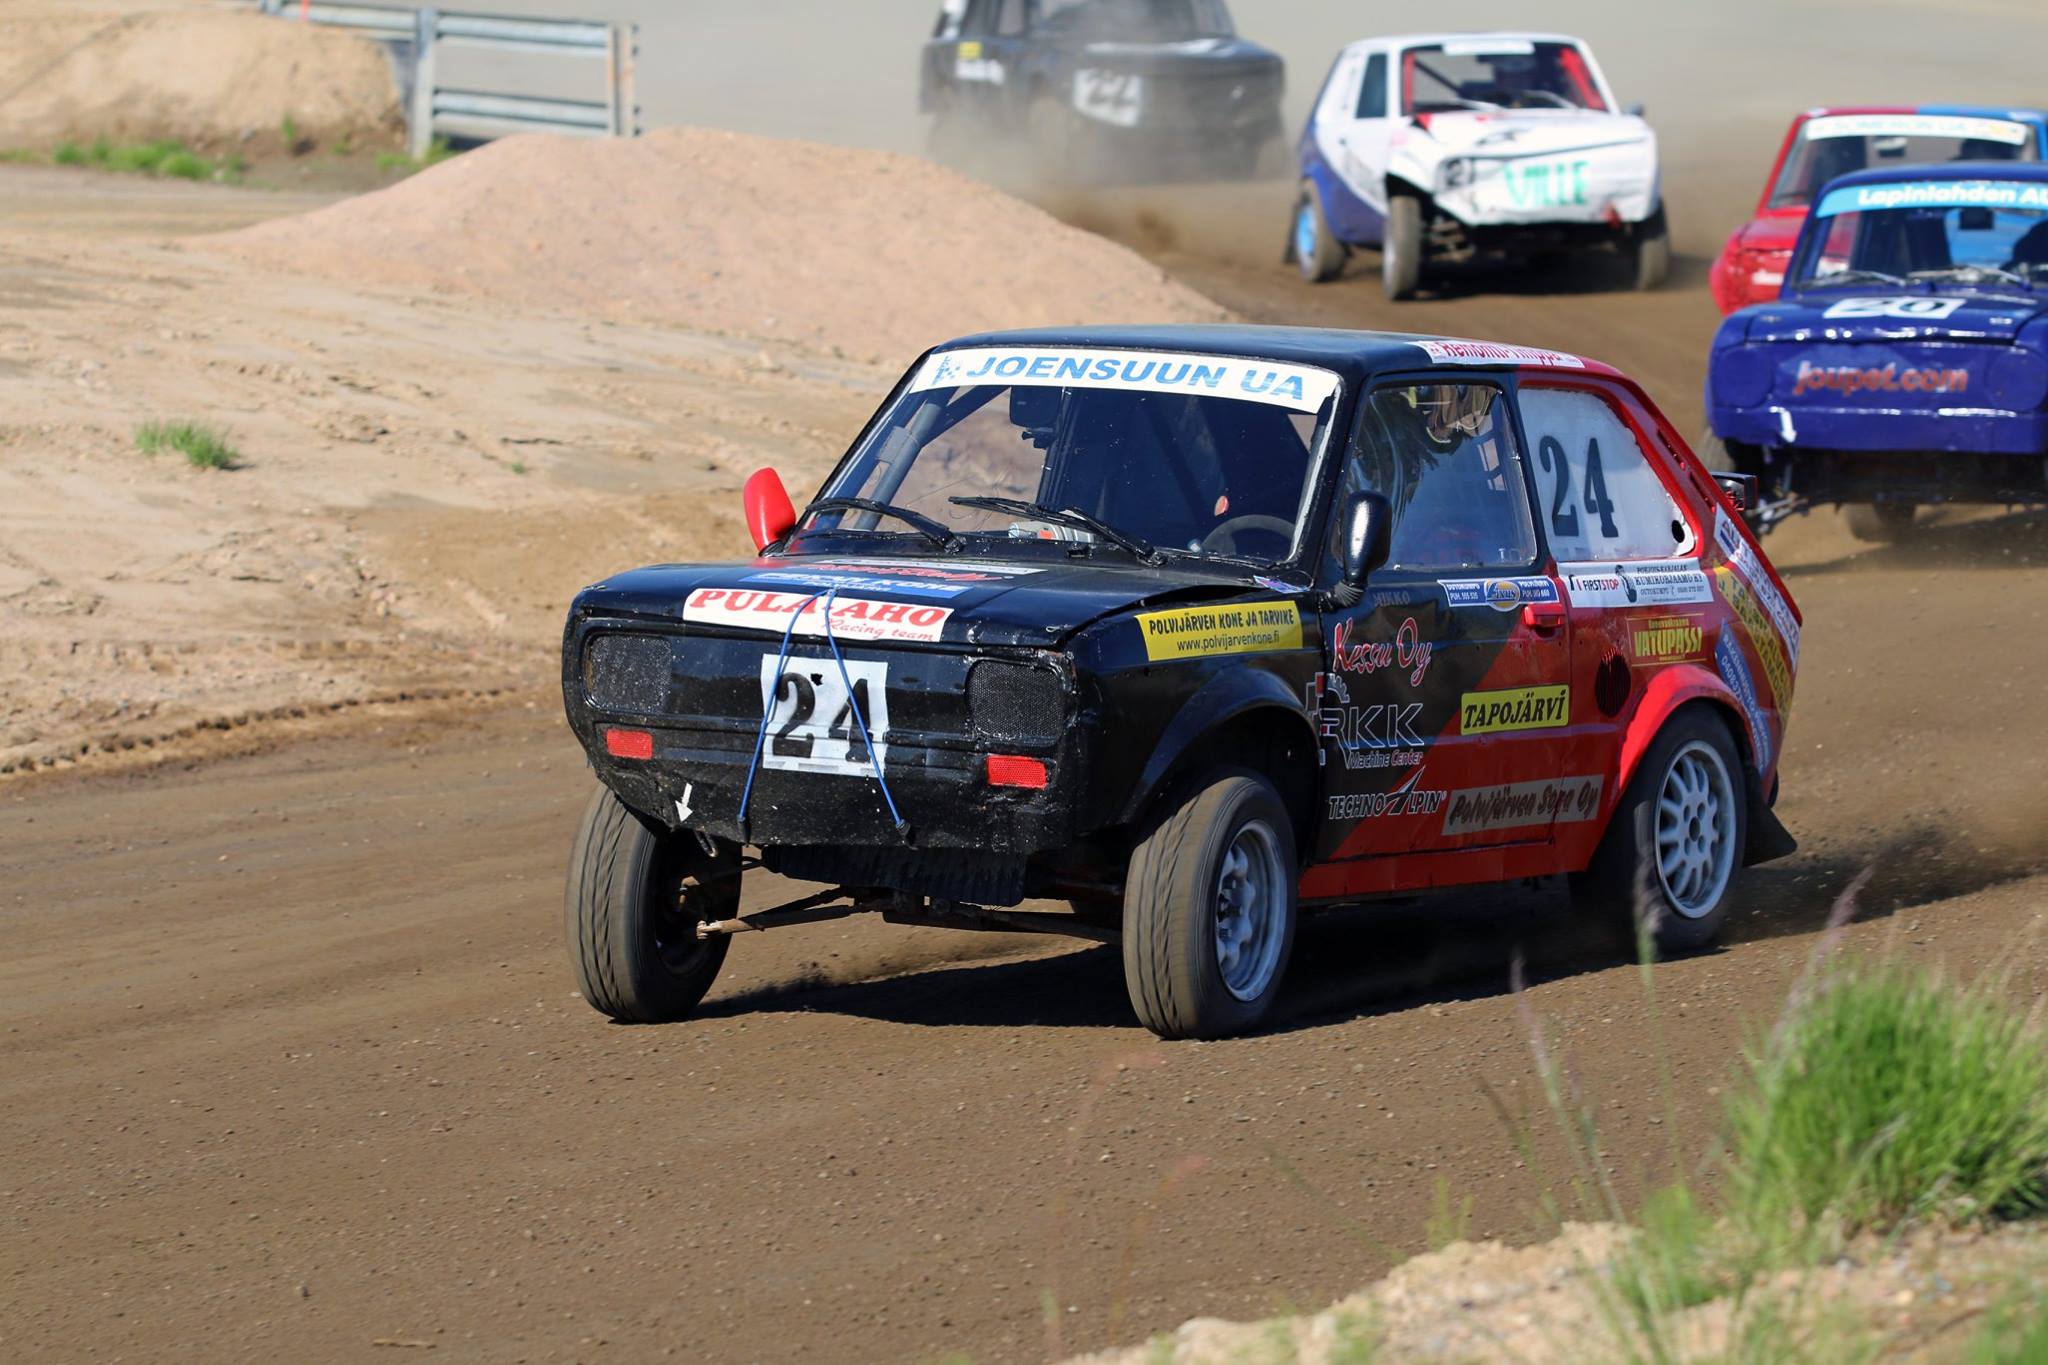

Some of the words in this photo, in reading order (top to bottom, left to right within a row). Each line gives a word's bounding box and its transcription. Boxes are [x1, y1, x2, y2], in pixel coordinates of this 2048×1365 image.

[1503, 161, 1588, 207] VILLE
[967, 355, 1228, 388] JOENSUUN
[1241, 369, 1303, 400] UA
[1539, 435, 1619, 538] 24
[821, 618, 885, 640] Racing
[891, 627, 934, 641] team
[1149, 613, 1216, 635] POLVIJÄRVEN
[1219, 613, 1244, 629] KONE
[1246, 611, 1258, 627] JA
[1258, 609, 1294, 626] TARVIKE
[1177, 630, 1280, 652] www.polvijarvenkone.fi
[772, 672, 874, 763] 24
[1464, 689, 1567, 729] TAPOJÄRVI
[1350, 751, 1390, 769] Machine
[1391, 750, 1424, 767] Center
